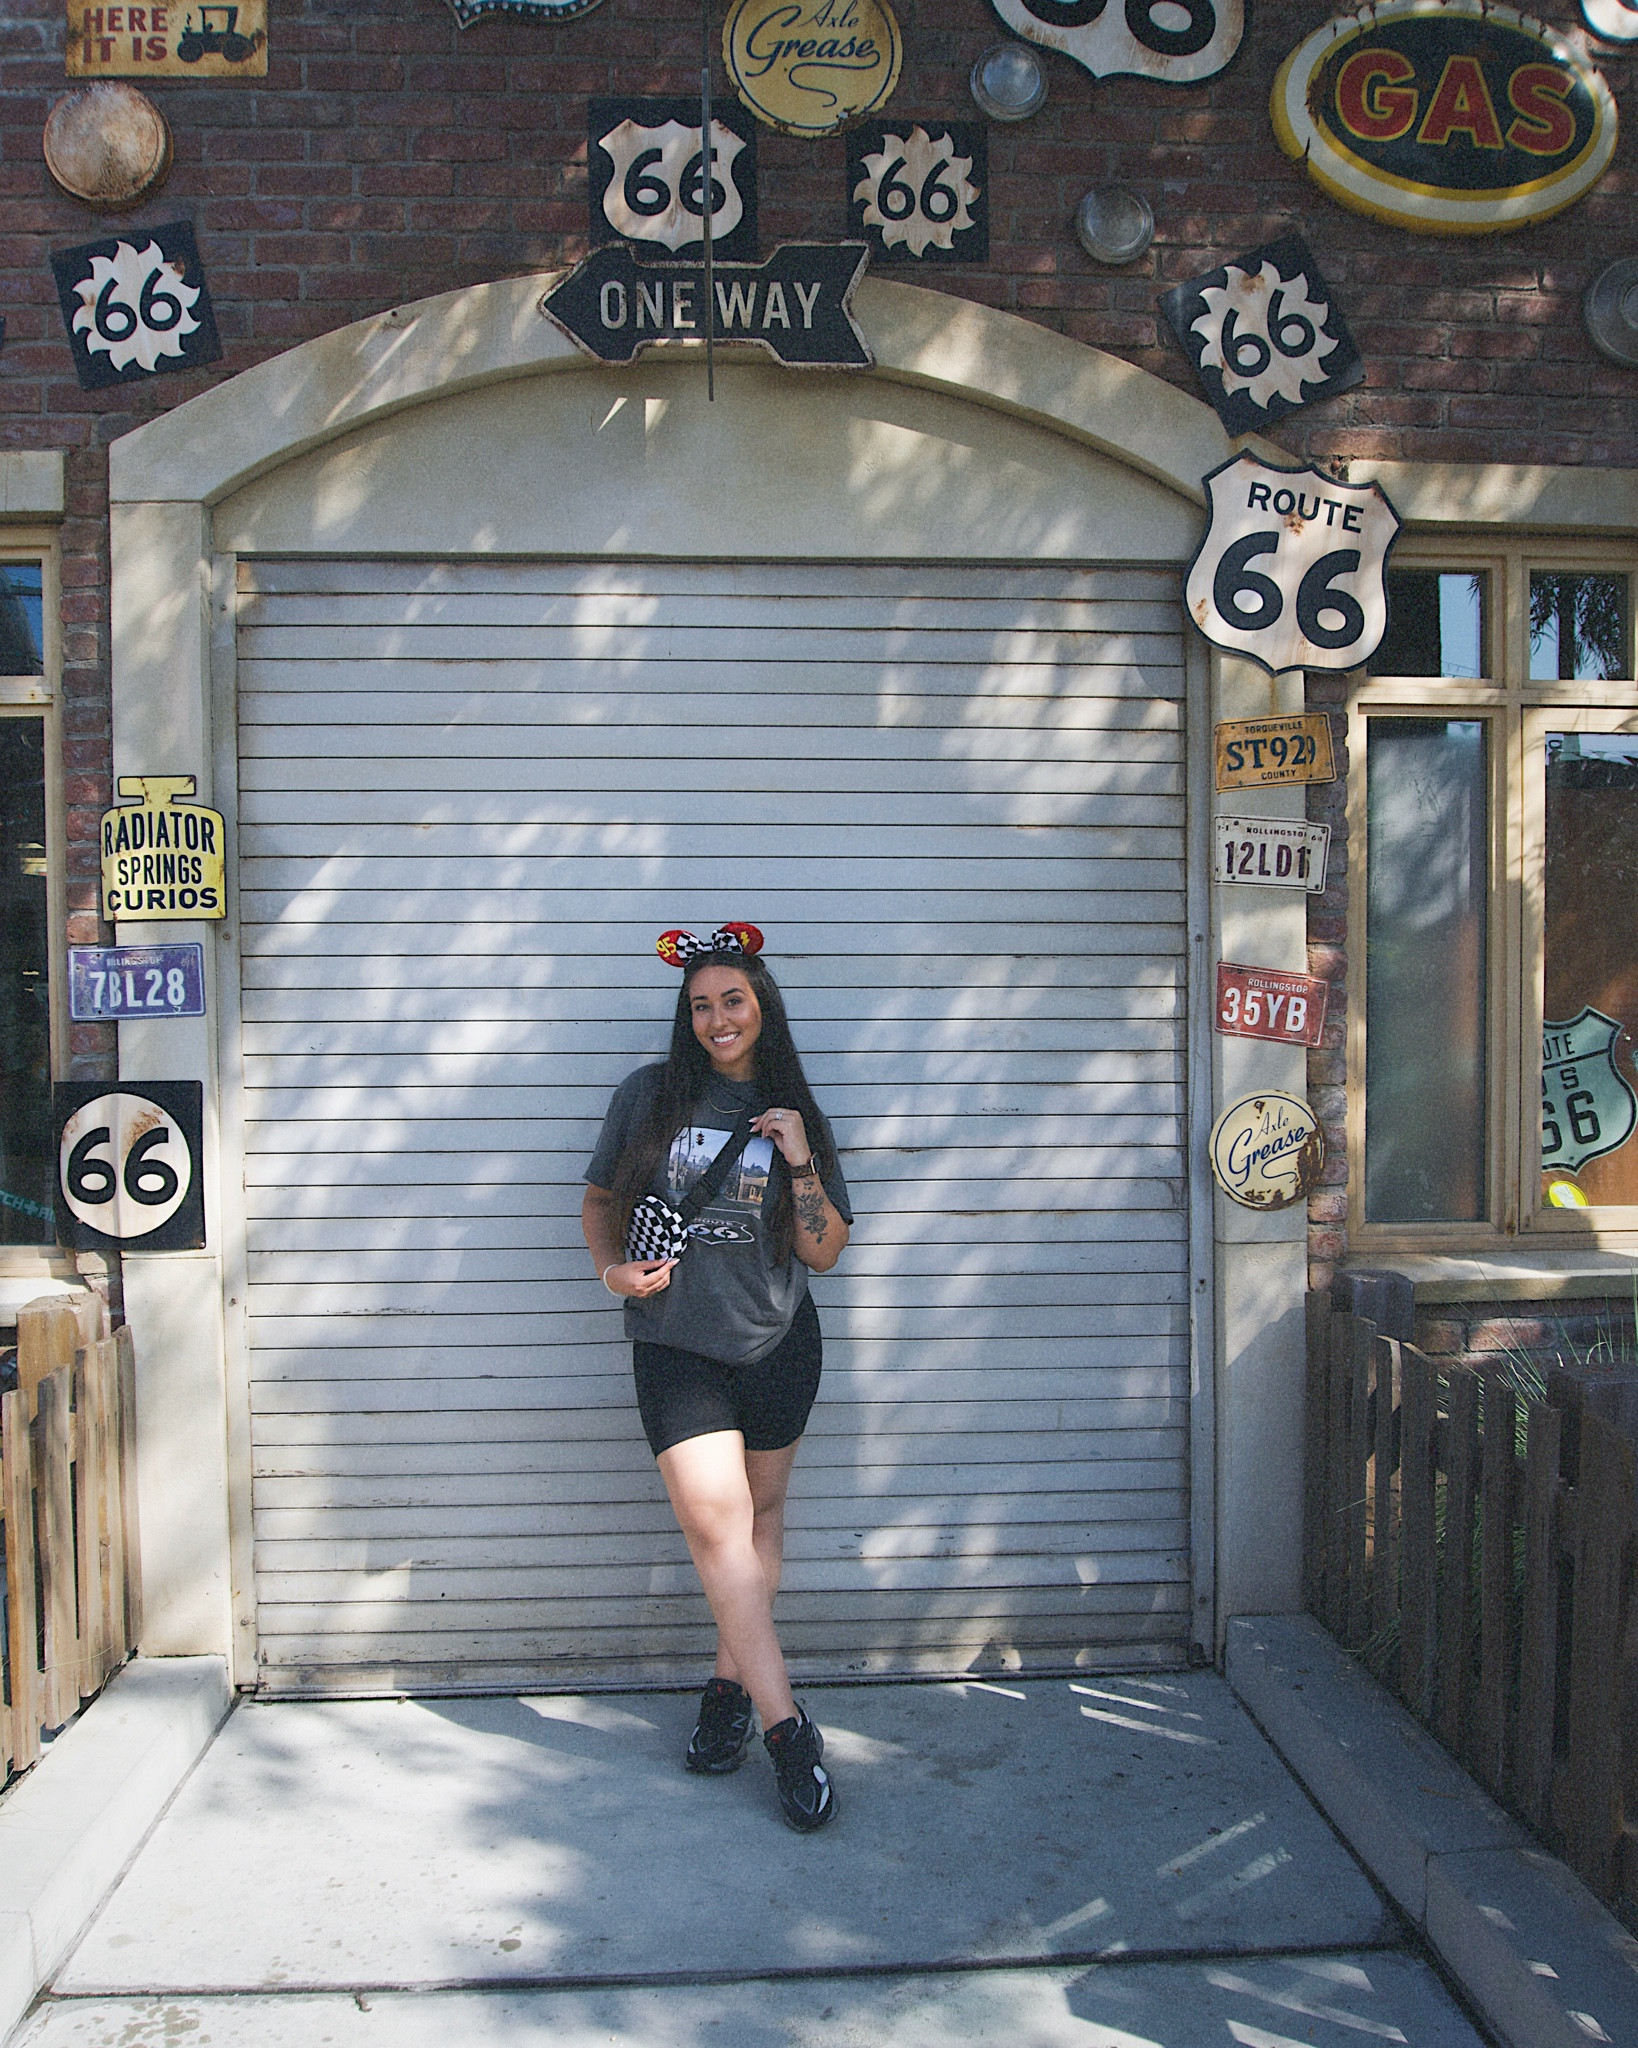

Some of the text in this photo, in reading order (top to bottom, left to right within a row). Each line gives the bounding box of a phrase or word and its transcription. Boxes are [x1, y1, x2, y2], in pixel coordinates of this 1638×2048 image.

[83, 7, 168, 32] HERE
[798, 0, 859, 28] Axle
[82, 36, 168, 63] IT IS
[745, 5, 881, 77] Grease
[1335, 48, 1578, 156] GAS
[624, 148, 727, 216] 66
[876, 158, 958, 222] 66
[95, 267, 182, 342] 66
[600, 281, 821, 329] ONE WAY
[1221, 289, 1316, 377] 66
[1247, 481, 1365, 534] ROUTE
[1213, 531, 1365, 649] 66
[1245, 721, 1303, 734] TORQUEVILLE
[1261, 769, 1296, 780] COUNTY
[104, 811, 216, 857] RADIATOR
[117, 854, 202, 885] SPRINGS
[107, 888, 218, 911] CURIOS
[656, 936, 677, 958] 95
[88, 968, 185, 1009] 7BL28
[1248, 978, 1308, 994] ROLLINGSTOP
[1222, 987, 1308, 1033] 35YB
[1254, 1106, 1290, 1141] Axle
[67, 1126, 179, 1206] 66
[1229, 1127, 1310, 1187] Grease
